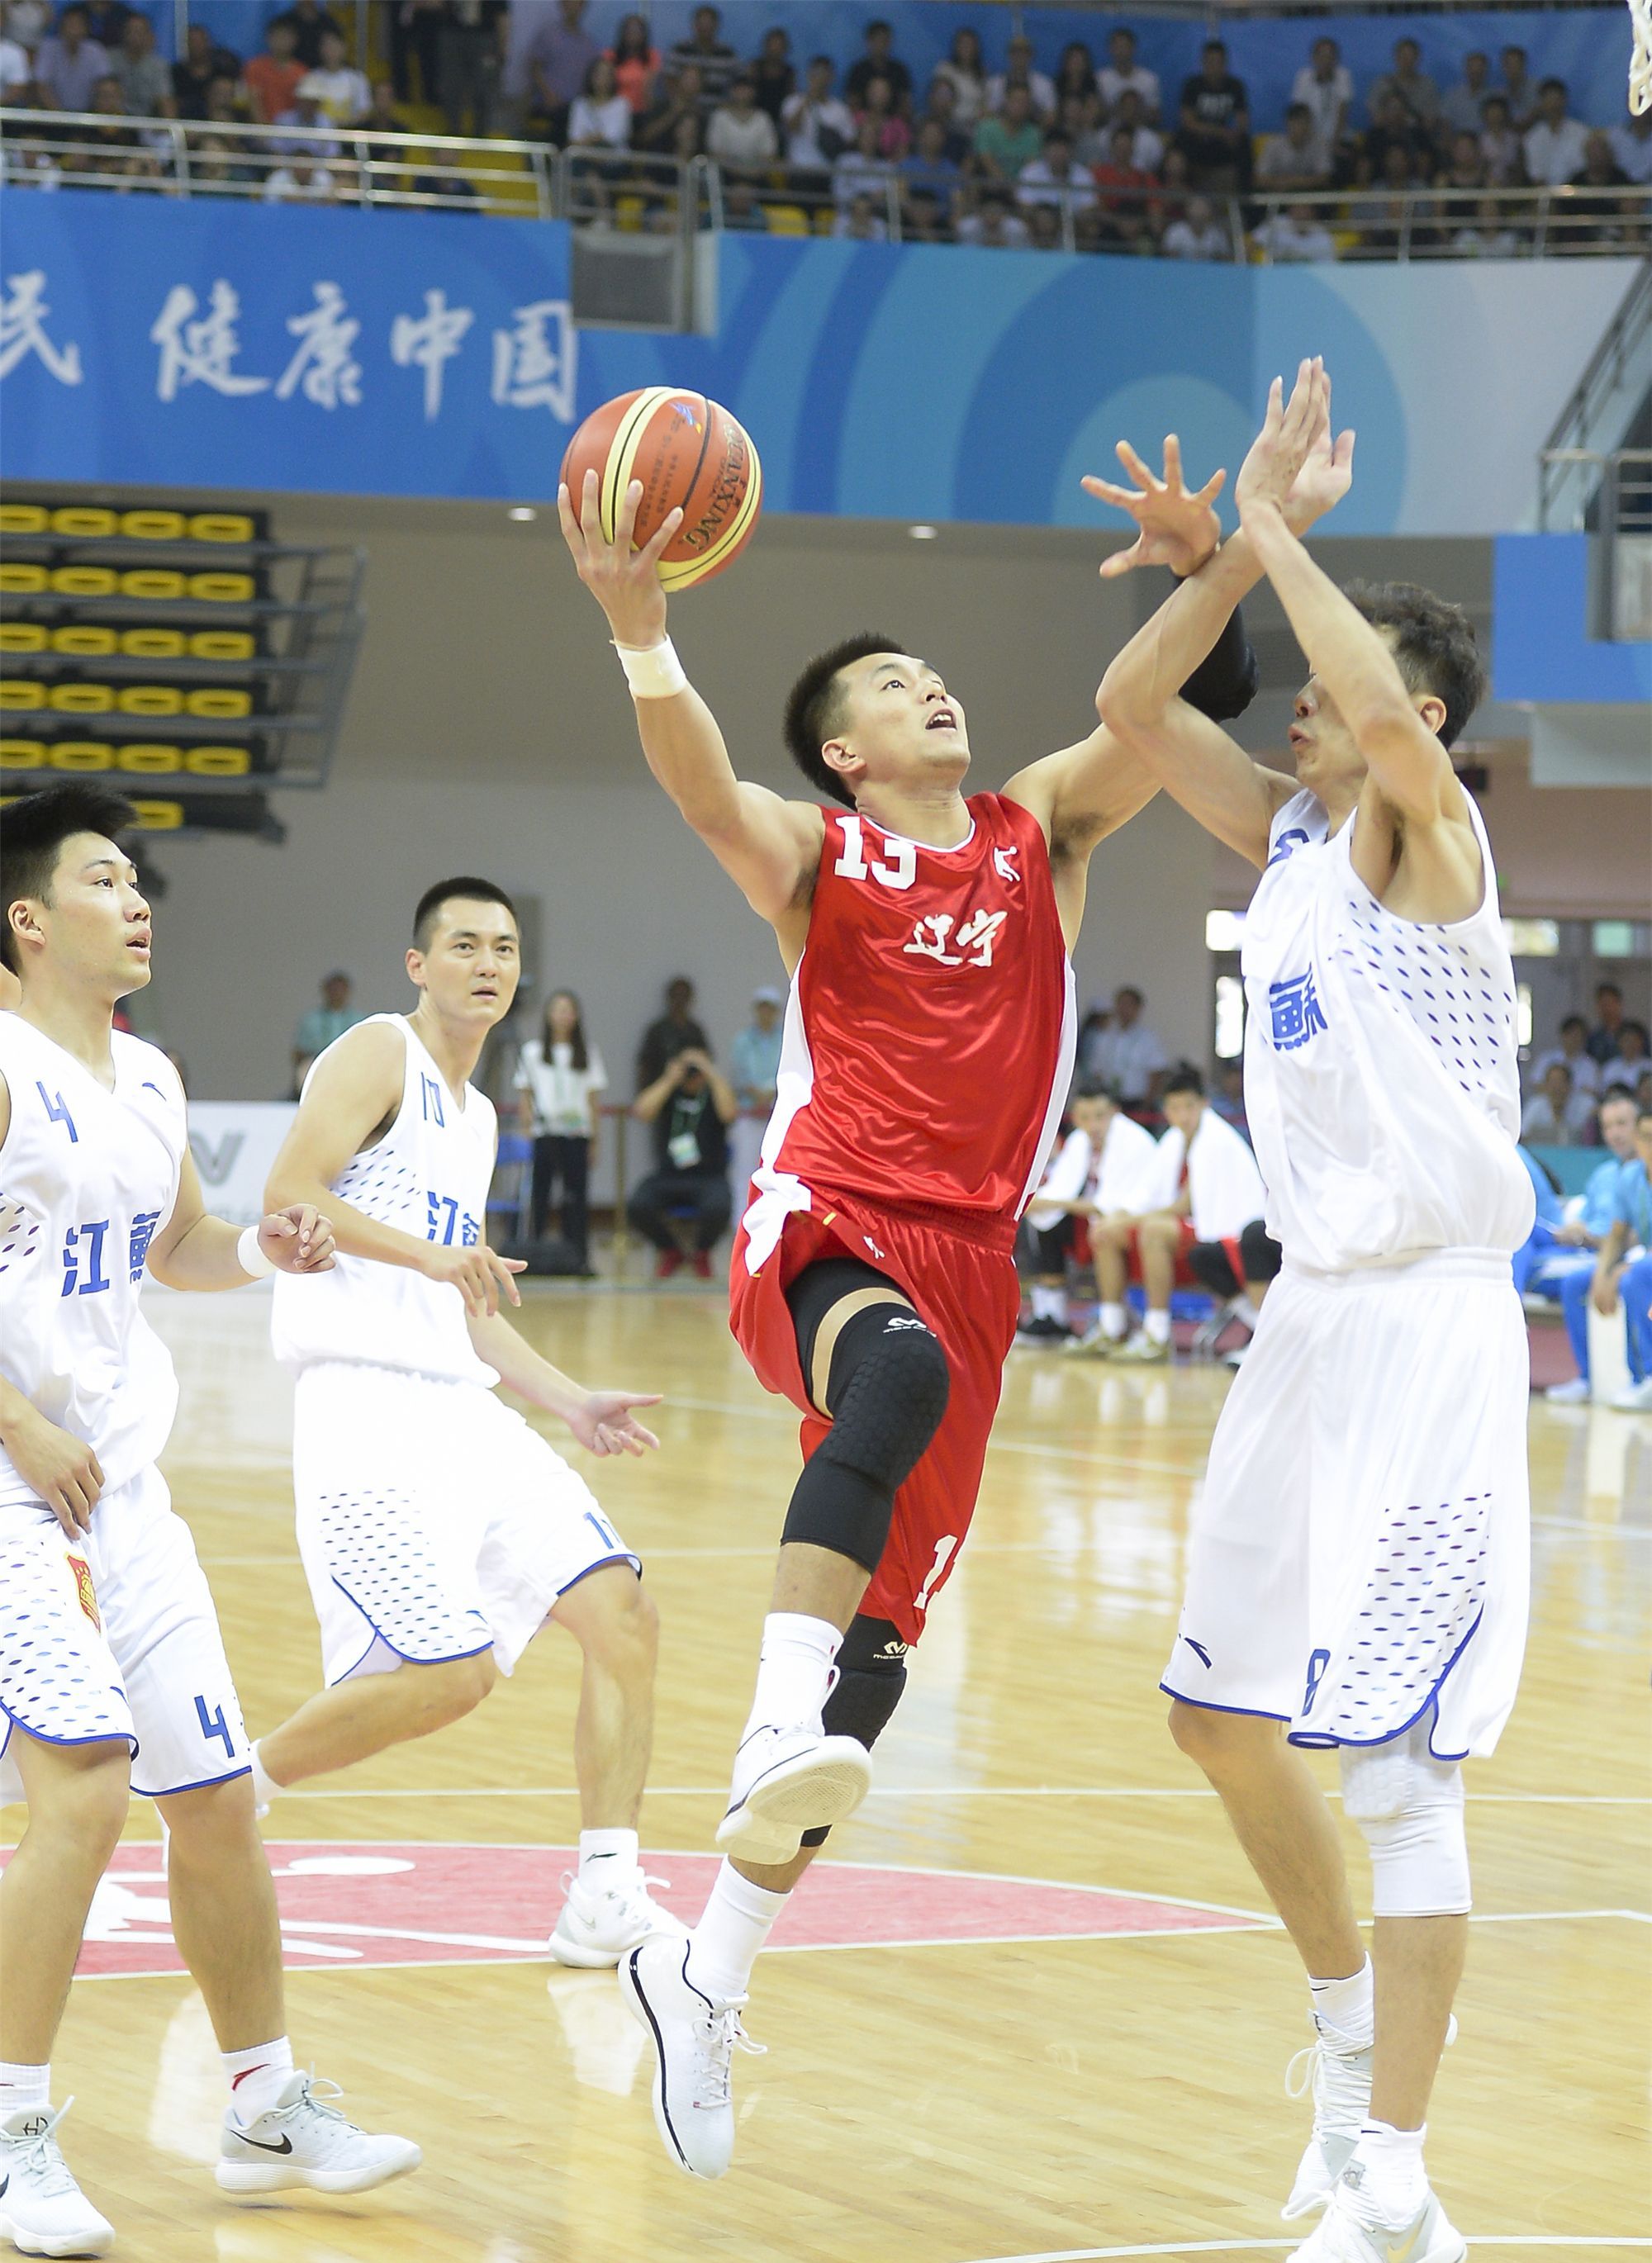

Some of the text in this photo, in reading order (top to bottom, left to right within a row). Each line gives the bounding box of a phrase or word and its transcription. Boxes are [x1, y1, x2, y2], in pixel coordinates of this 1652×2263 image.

[0, 269, 576, 425] 民 健康中国
[36, 1080, 79, 1143] 4
[1301, 1648, 1332, 1717] 8
[193, 1695, 235, 1758] 4
